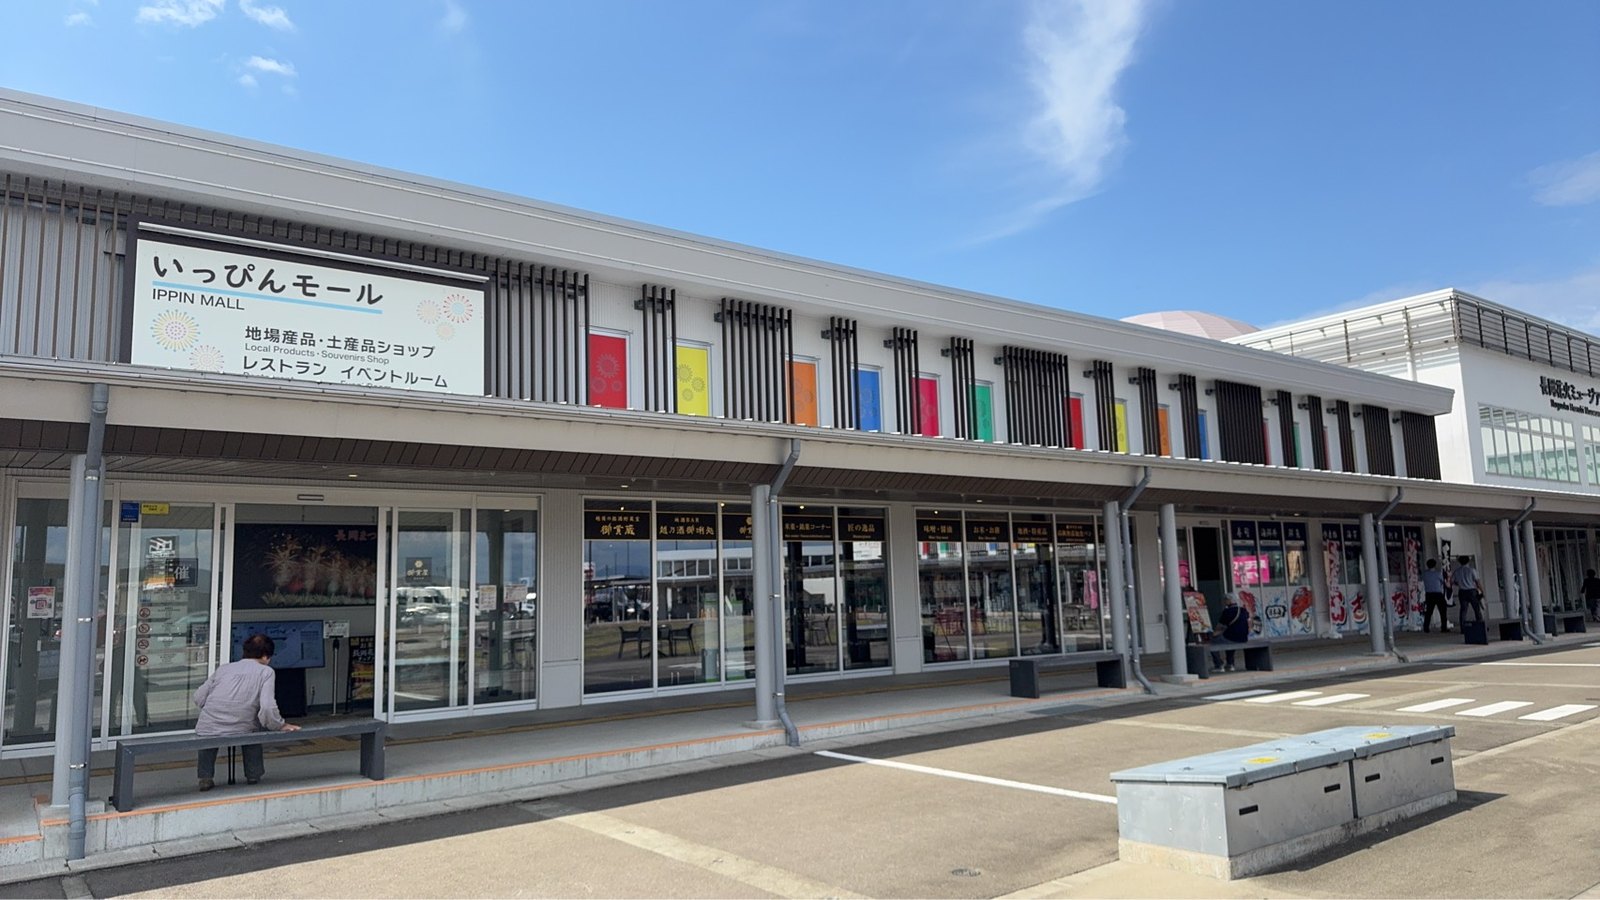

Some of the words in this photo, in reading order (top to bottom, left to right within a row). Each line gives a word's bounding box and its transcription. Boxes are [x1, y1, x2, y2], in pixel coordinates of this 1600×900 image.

[153, 256, 383, 305] いっぴんモール
[152, 288, 195, 305] IPPIN
[200, 294, 245, 310] MALL
[244, 343, 271, 354] Local
[366, 353, 390, 366] Shop
[243, 355, 328, 377] レストラン
[340, 366, 448, 389] イベントルーム
